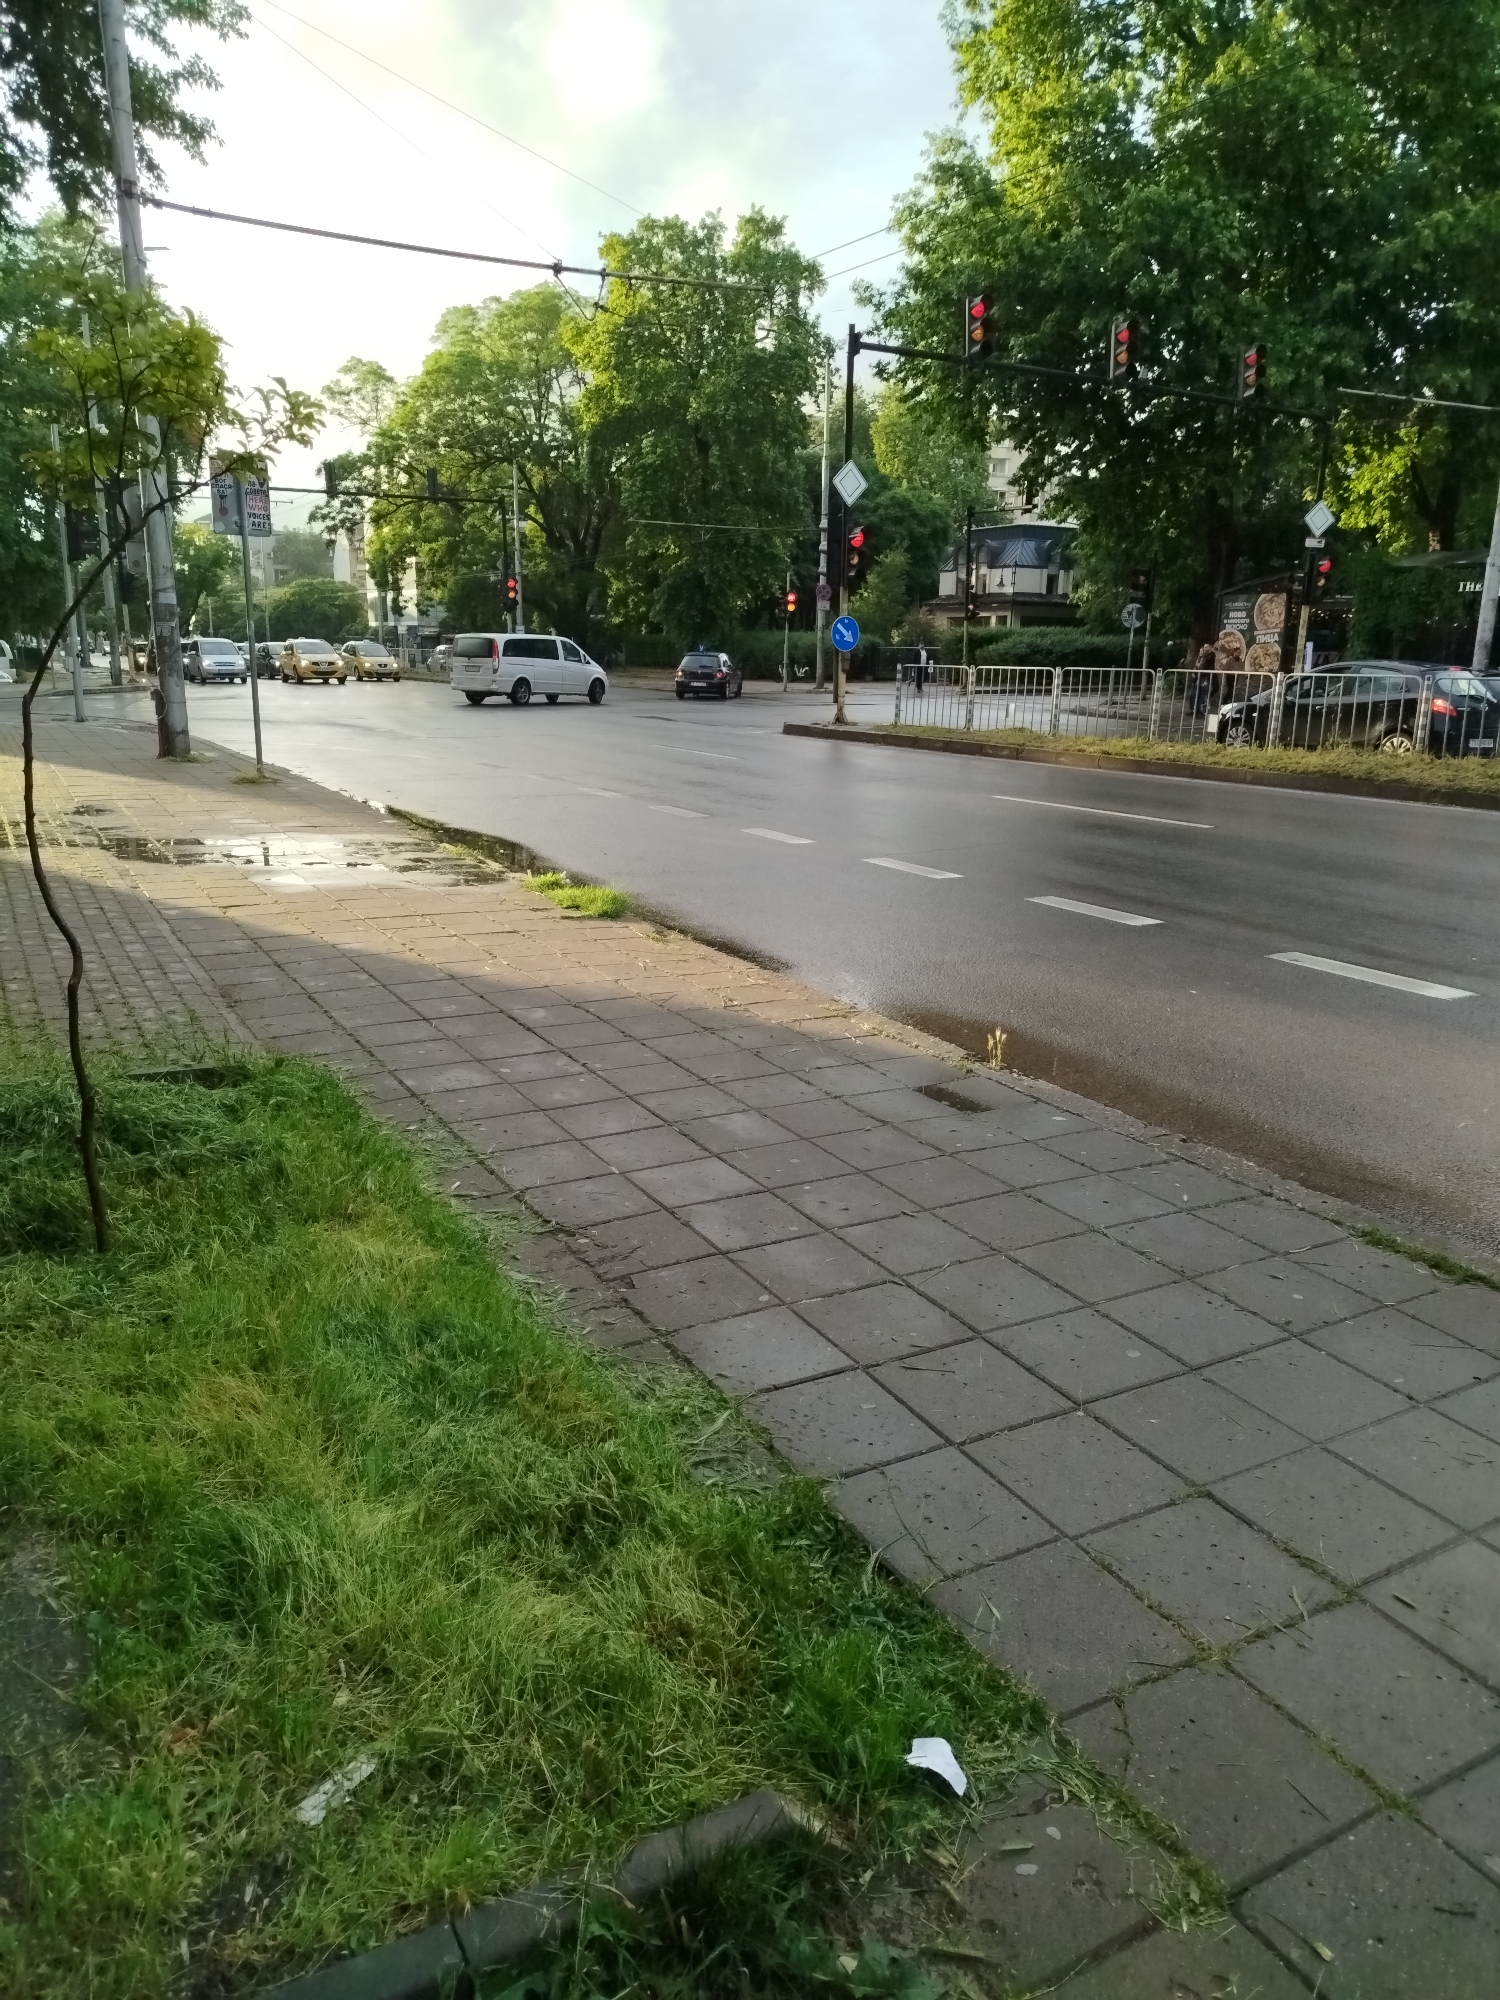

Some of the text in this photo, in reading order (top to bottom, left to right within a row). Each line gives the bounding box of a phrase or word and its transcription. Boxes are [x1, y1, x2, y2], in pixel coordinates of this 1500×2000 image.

[249, 496, 269, 504] HERE
[248, 504, 269, 512] WHO
[1458, 582, 1483, 592] THE
[1256, 633, 1279, 643] ПИЦА
